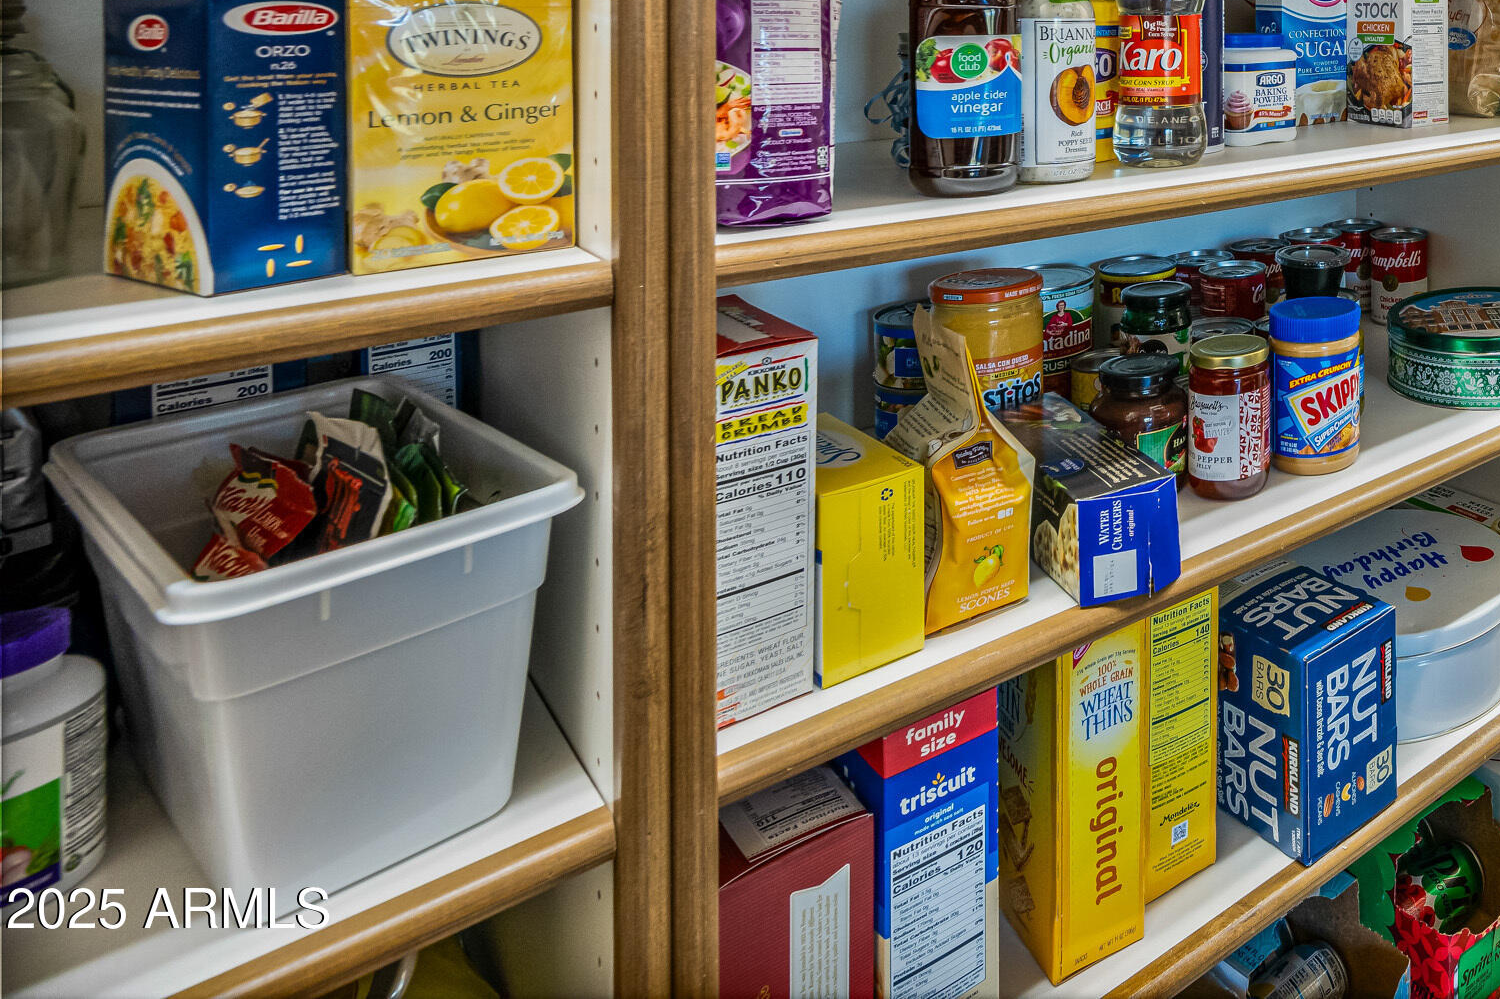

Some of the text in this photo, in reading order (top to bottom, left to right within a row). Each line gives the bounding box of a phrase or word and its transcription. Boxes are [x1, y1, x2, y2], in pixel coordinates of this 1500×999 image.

[252, 9, 329, 26] Barilla
[1355, 2, 1398, 19] STOCK
[1144, 20, 1156, 32] 0g
[1289, 29, 1346, 38] CONFECTION
[1362, 23, 1390, 32] CHICKEN
[256, 46, 311, 58] ORZO
[401, 28, 532, 52] TWININGS
[1295, 41, 1346, 58] SUGA
[270, 62, 297, 71] n.26
[958, 52, 982, 62] food
[959, 62, 981, 71] club
[1120, 41, 1182, 71] Karo
[414, 80, 521, 92] HERBAL TEA
[1255, 88, 1287, 96] BAKING
[1259, 75, 1282, 85] ARGO
[951, 90, 1008, 103] apple cider
[951, 101, 1004, 116] vinegar
[1253, 95, 1289, 104] POWDER
[368, 102, 561, 129] Lemon & Ginger
[1058, 137, 1093, 147] POPPY SEED
[1043, 328, 1090, 352] tadina
[372, 348, 452, 372] Calories 200
[748, 364, 786, 376] KIKKOMAN
[976, 363, 996, 371] SALSA
[1012, 354, 1028, 365] QUESO
[720, 367, 802, 405] PANKO
[994, 370, 1016, 378] MEDIUM
[1289, 360, 1352, 389] EXTRA CRUNCHY
[157, 383, 268, 414] Calories 200
[1300, 371, 1360, 426] SKIPPY
[721, 406, 802, 431] BREAD
[721, 415, 802, 440] CRUMBS
[716, 434, 808, 463] Nutrition Facts
[776, 457, 789, 466] Cup
[1197, 456, 1233, 464] PEPPER
[716, 467, 806, 501] Calories 110
[1098, 509, 1110, 545] WATER
[1112, 500, 1122, 550] CRACKERS
[1126, 509, 1136, 537] original
[1323, 532, 1438, 579] Birthday
[1363, 552, 1448, 589] Happy
[957, 591, 979, 603] LEMON
[960, 588, 1010, 613] SCONES
[1242, 576, 1333, 628] BARS
[1153, 598, 1210, 625] Nutrition Facts
[1273, 588, 1359, 641] NUT
[1326, 602, 1374, 632] KIRKLAND
[1153, 624, 1210, 654] Calories 140
[1079, 666, 1134, 697] WHOLE GRAIN
[1098, 660, 1117, 678] 100%
[1255, 660, 1265, 700] BARS
[1384, 640, 1393, 700] KIRKLAND
[1079, 681, 1134, 716] WHEAT
[1266, 663, 1285, 711] 30
[1352, 647, 1378, 745] NUT
[906, 709, 966, 745] family
[1082, 698, 1133, 741] THINS
[1327, 664, 1350, 771] BARS
[920, 732, 956, 757] size
[1223, 701, 1249, 821] BARS
[1376, 750, 1391, 783] 30
[900, 765, 976, 815] triscuit
[1249, 715, 1279, 843] NUT
[1288, 740, 1300, 816] KIRKLAND
[925, 803, 954, 824] original
[892, 809, 983, 861] Nutrition Facts
[1090, 756, 1124, 905] original
[893, 849, 936, 876] Serving size
[893, 839, 983, 895] Calories 120
[1461, 951, 1493, 987] Sprite
